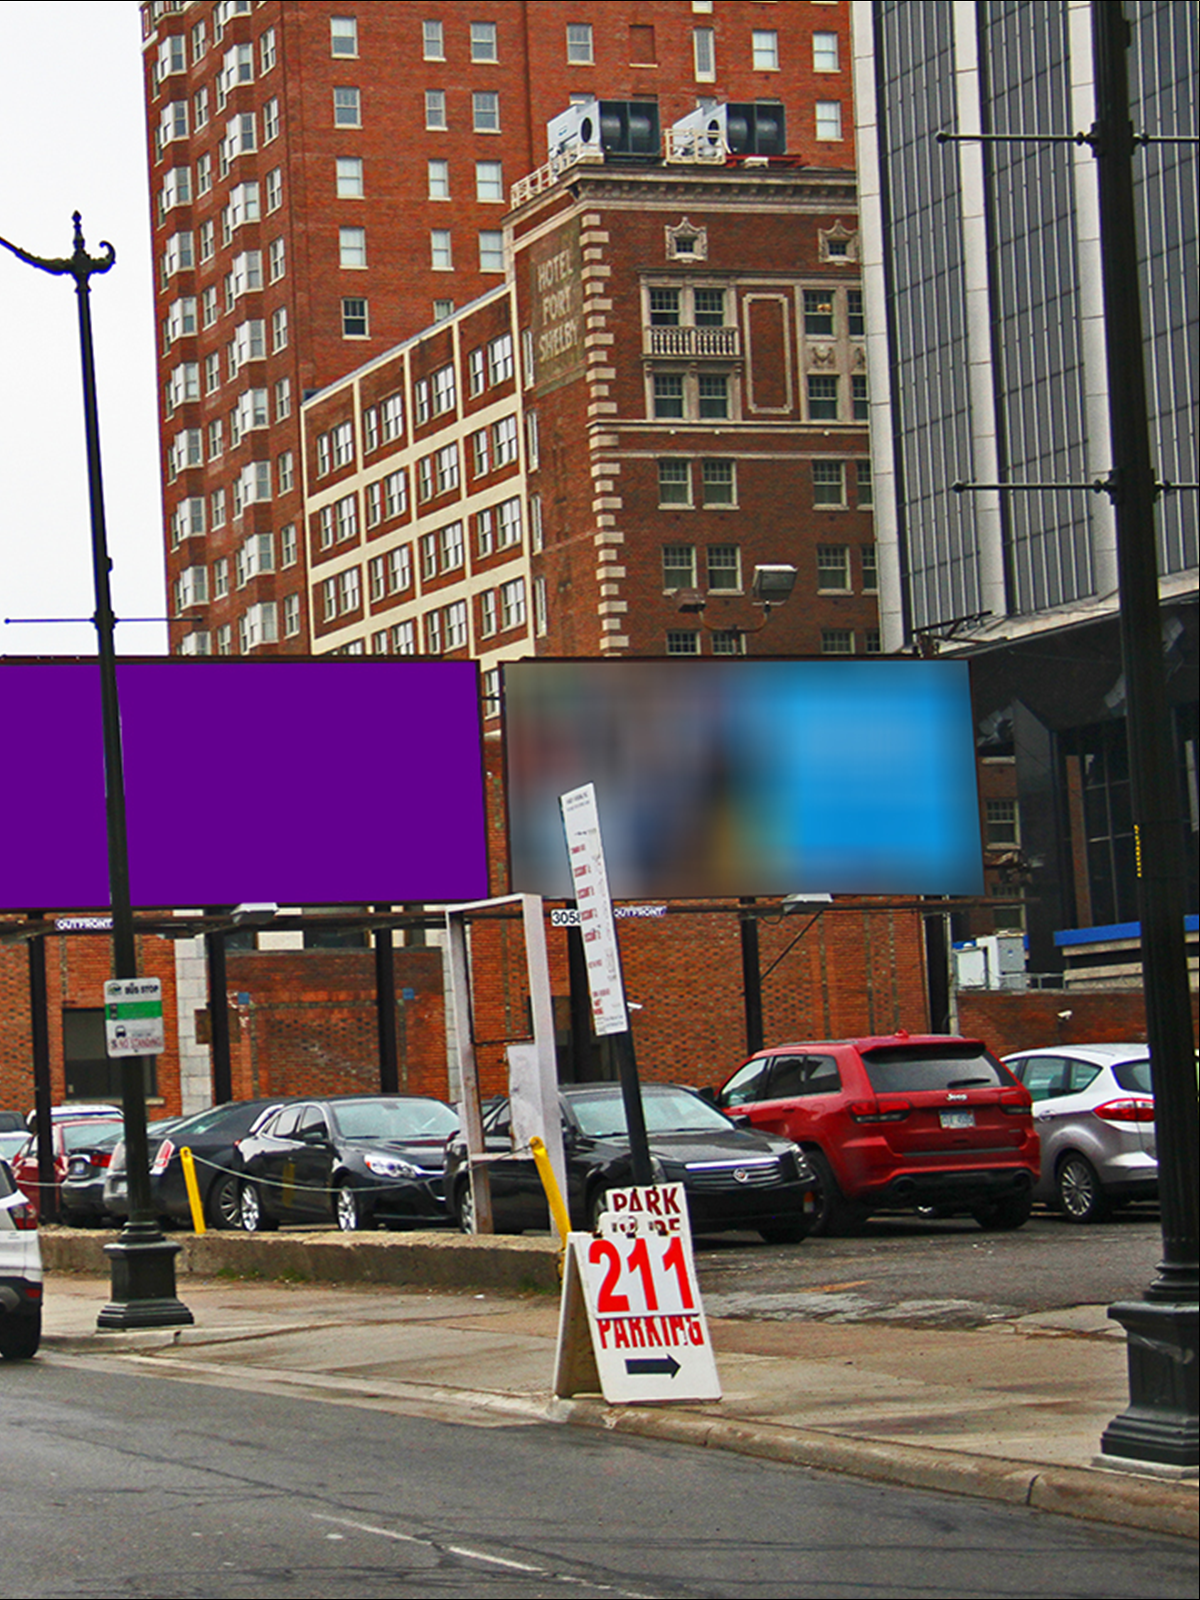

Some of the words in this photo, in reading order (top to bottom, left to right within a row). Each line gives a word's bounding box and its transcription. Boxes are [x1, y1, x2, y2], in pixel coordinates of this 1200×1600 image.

[538, 249, 574, 292] HOTEL
[543, 285, 571, 326] FORT
[539, 319, 578, 362] SHELBY
[124, 986, 139, 995] BUS
[141, 984, 159, 994] STOP
[612, 1187, 681, 1216] PARK
[588, 1236, 695, 1313] 211
[597, 1315, 705, 1349] PARKING
